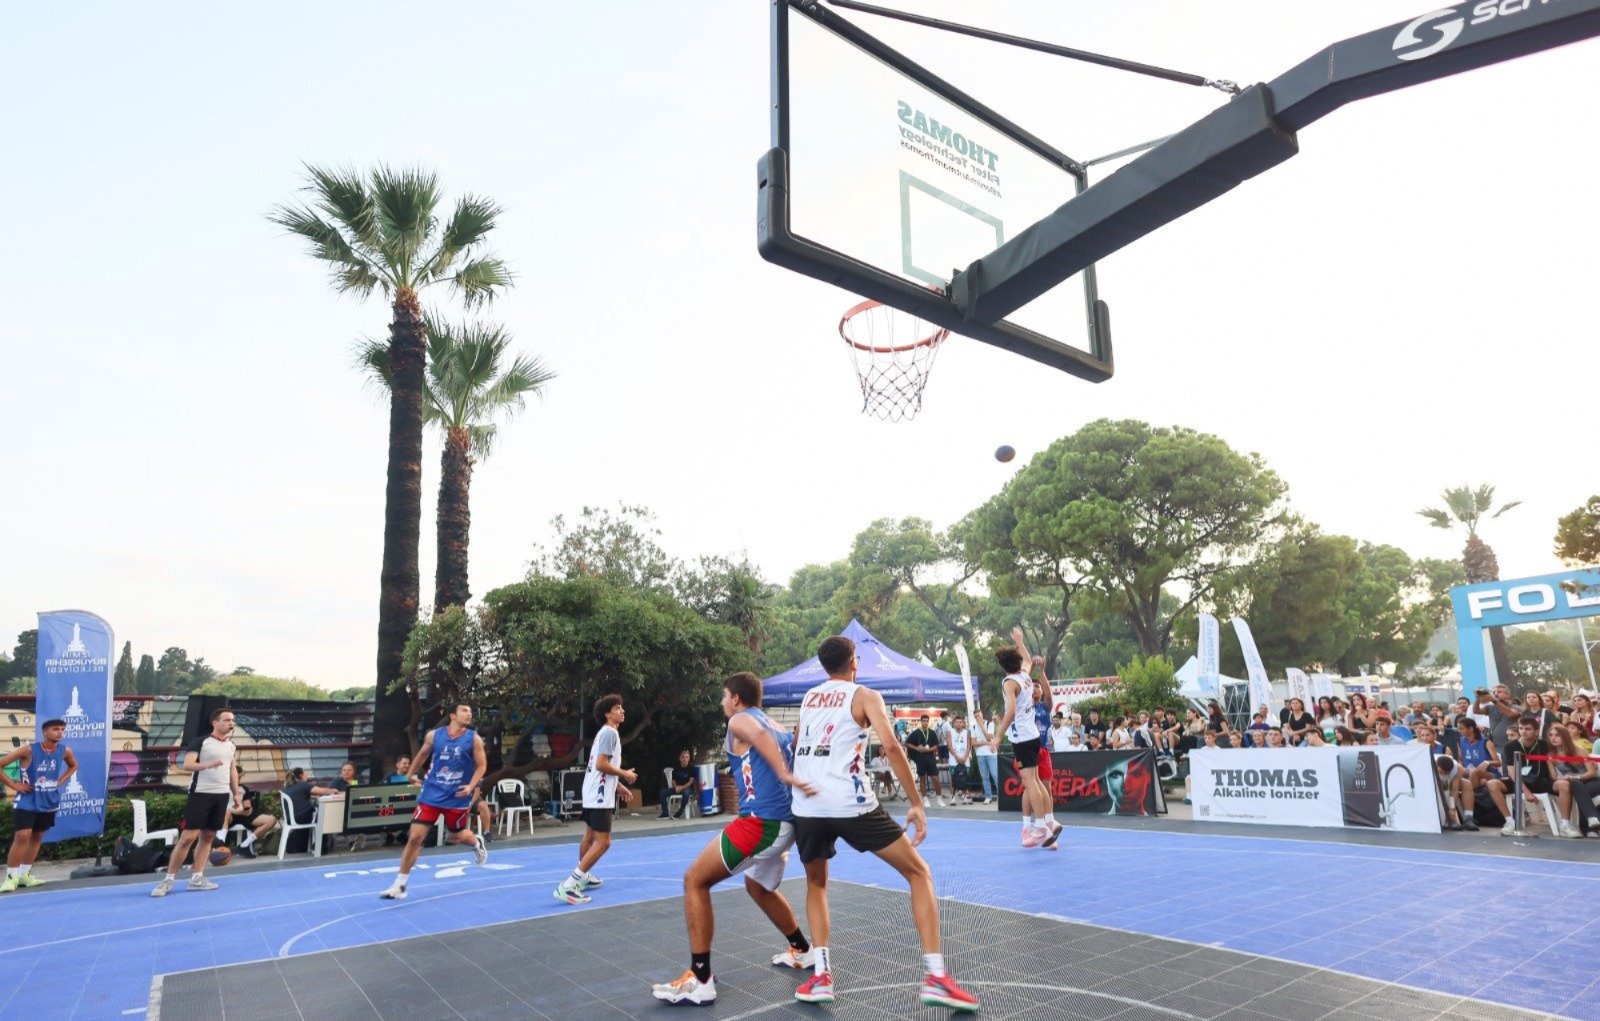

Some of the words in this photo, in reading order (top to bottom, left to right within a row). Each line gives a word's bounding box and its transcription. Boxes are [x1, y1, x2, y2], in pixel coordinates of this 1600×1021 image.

[1211, 769, 1319, 787] THOMAS
[1213, 788, 1266, 798] Alkaline
[1270, 788, 1320, 799] Ionizer
